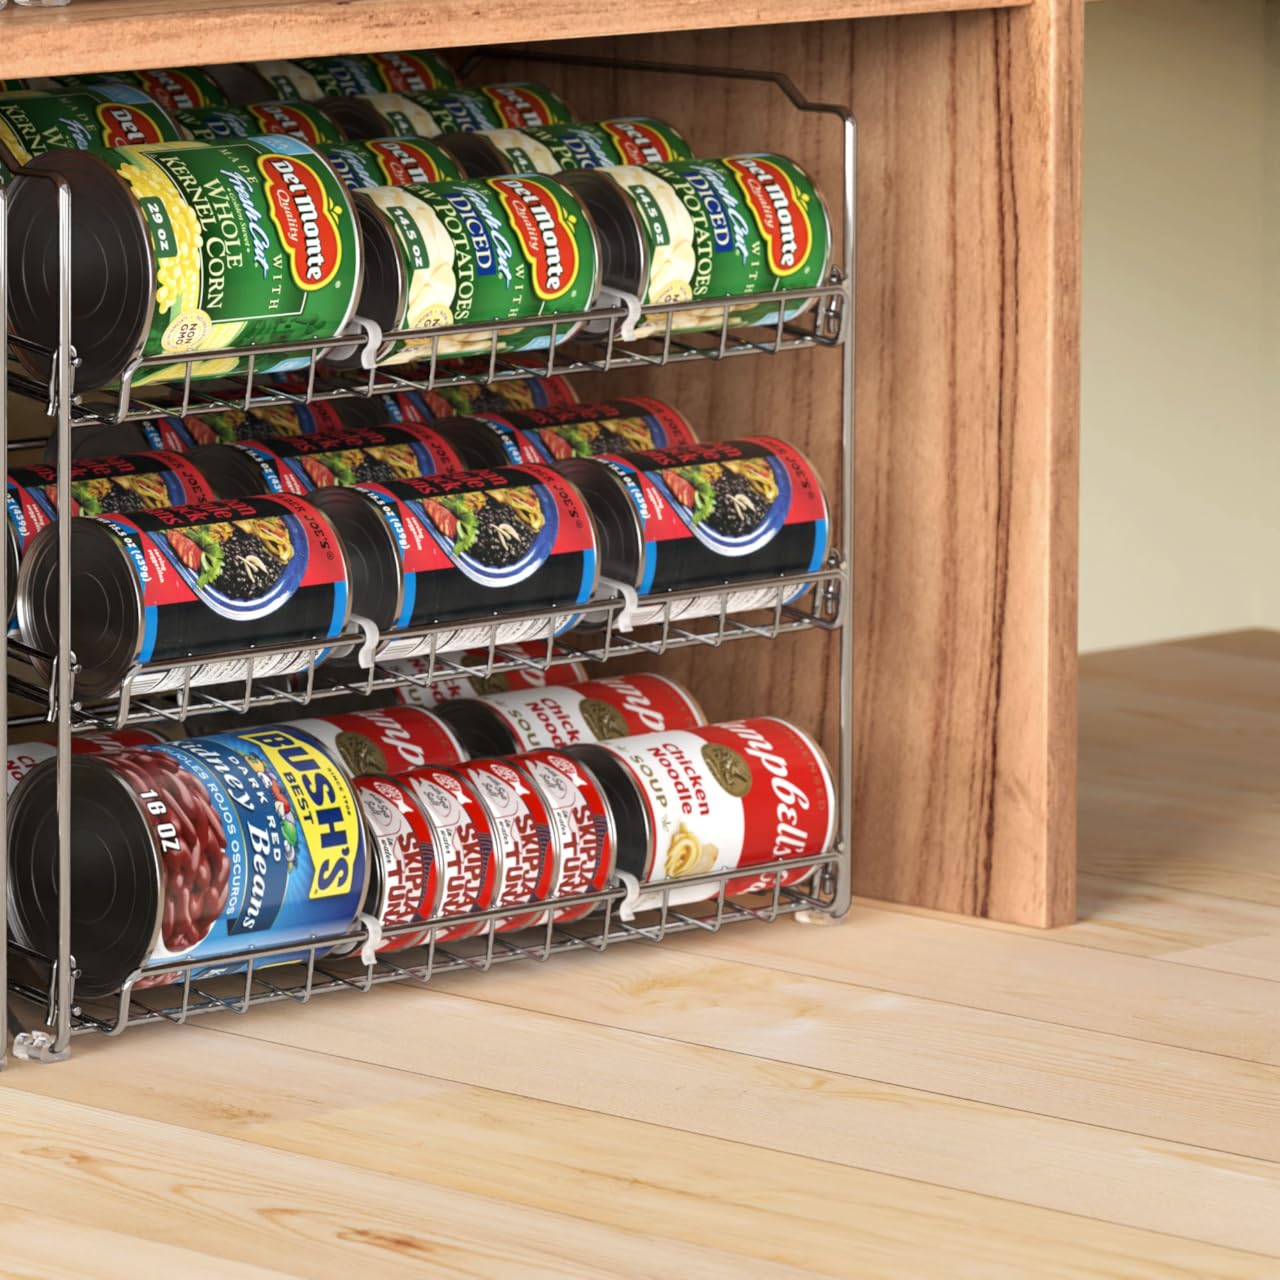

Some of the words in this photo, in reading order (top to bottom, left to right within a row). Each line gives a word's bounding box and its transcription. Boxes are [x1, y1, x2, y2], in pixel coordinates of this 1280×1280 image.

[147, 202, 164, 227] 29
[157, 155, 209, 233] KERNEL
[205, 236, 226, 310] CORN
[206, 178, 245, 269] WHOLE
[272, 160, 307, 192] Del
[294, 195, 325, 280] Monte
[276, 189, 298, 243] Quality
[393, 209, 421, 245] 14.5
[446, 193, 493, 270] DICED
[502, 180, 532, 207] Del
[530, 207, 564, 291] Monte
[511, 197, 540, 250] Quality
[633, 187, 658, 221] 14.5
[673, 179, 715, 296] POTATOES
[688, 172, 730, 247] DICED
[739, 159, 765, 185] Del
[764, 185, 796, 267] Monte
[747, 177, 775, 229] Quality
[269, 254, 283, 309] WITH
[435, 204, 475, 321] POTATOES
[176, 324, 188, 345] GMO
[185, 323, 197, 344] NON
[556, 488, 579, 520] JOE'S
[786, 454, 811, 491] JOE'S
[303, 512, 331, 552] JOE'S
[227, 755, 268, 804] DARK
[266, 815, 281, 862] RED
[258, 733, 350, 891] BUSH'S
[284, 772, 313, 824] BEST
[630, 754, 668, 808] SOUP
[646, 746, 693, 815] Noodle
[662, 742, 710, 816] Chicken
[722, 721, 810, 860] mpbell's
[139, 789, 166, 815] 16
[156, 824, 180, 852] OZ
[207, 782, 236, 835] ROJOS
[226, 840, 241, 915] OSCUROS
[243, 821, 271, 930] Beans
[398, 832, 422, 922] SKIPJA
